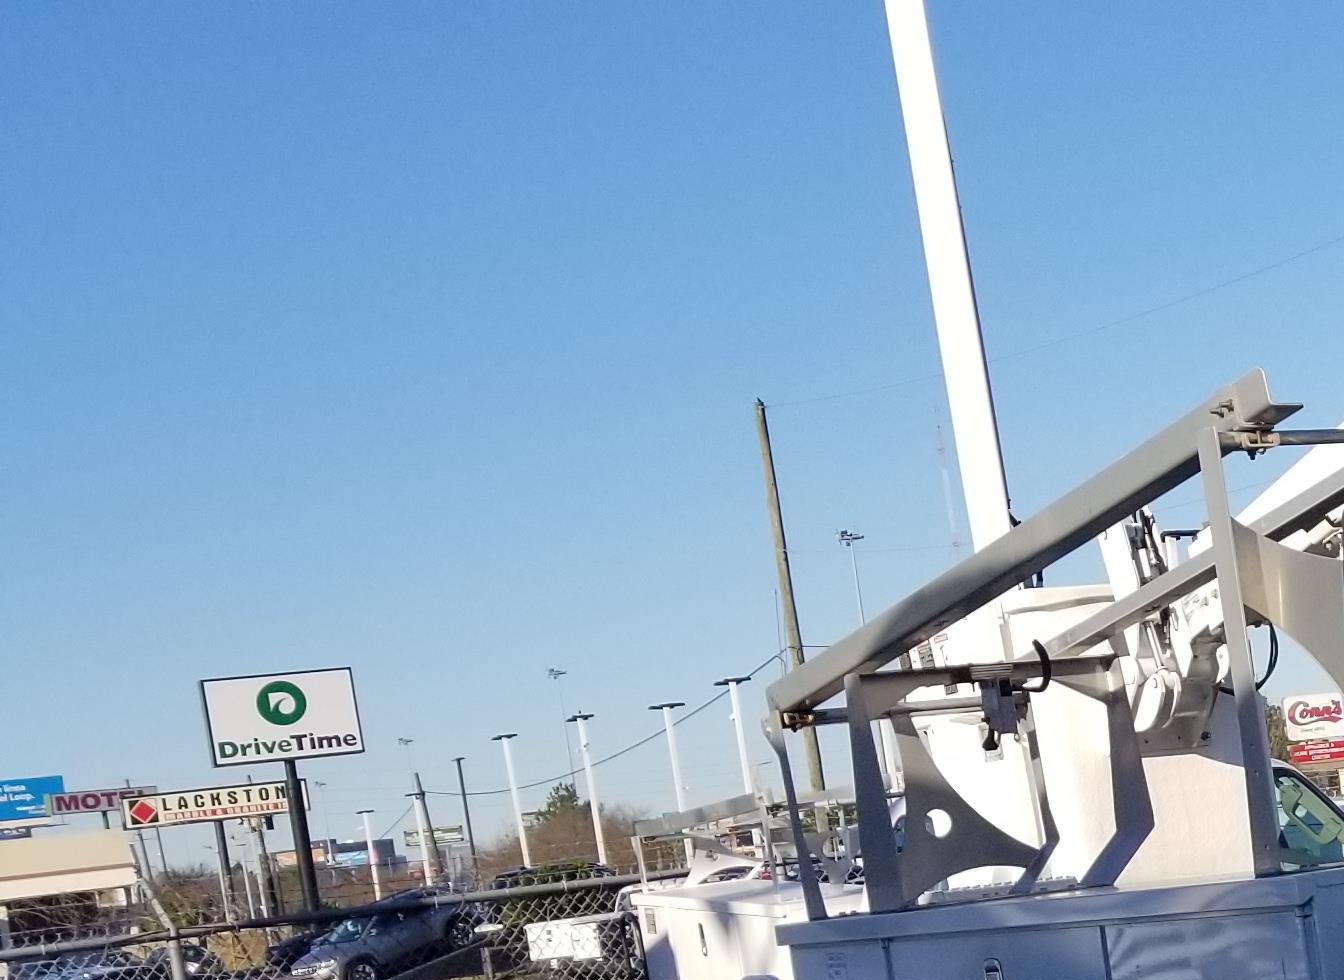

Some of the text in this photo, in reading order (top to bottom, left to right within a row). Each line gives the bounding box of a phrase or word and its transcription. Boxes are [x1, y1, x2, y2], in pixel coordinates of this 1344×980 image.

[1288, 700, 1342, 726] Conn's
[217, 733, 357, 758] DriveTime
[161, 785, 286, 812] LACKSTON
